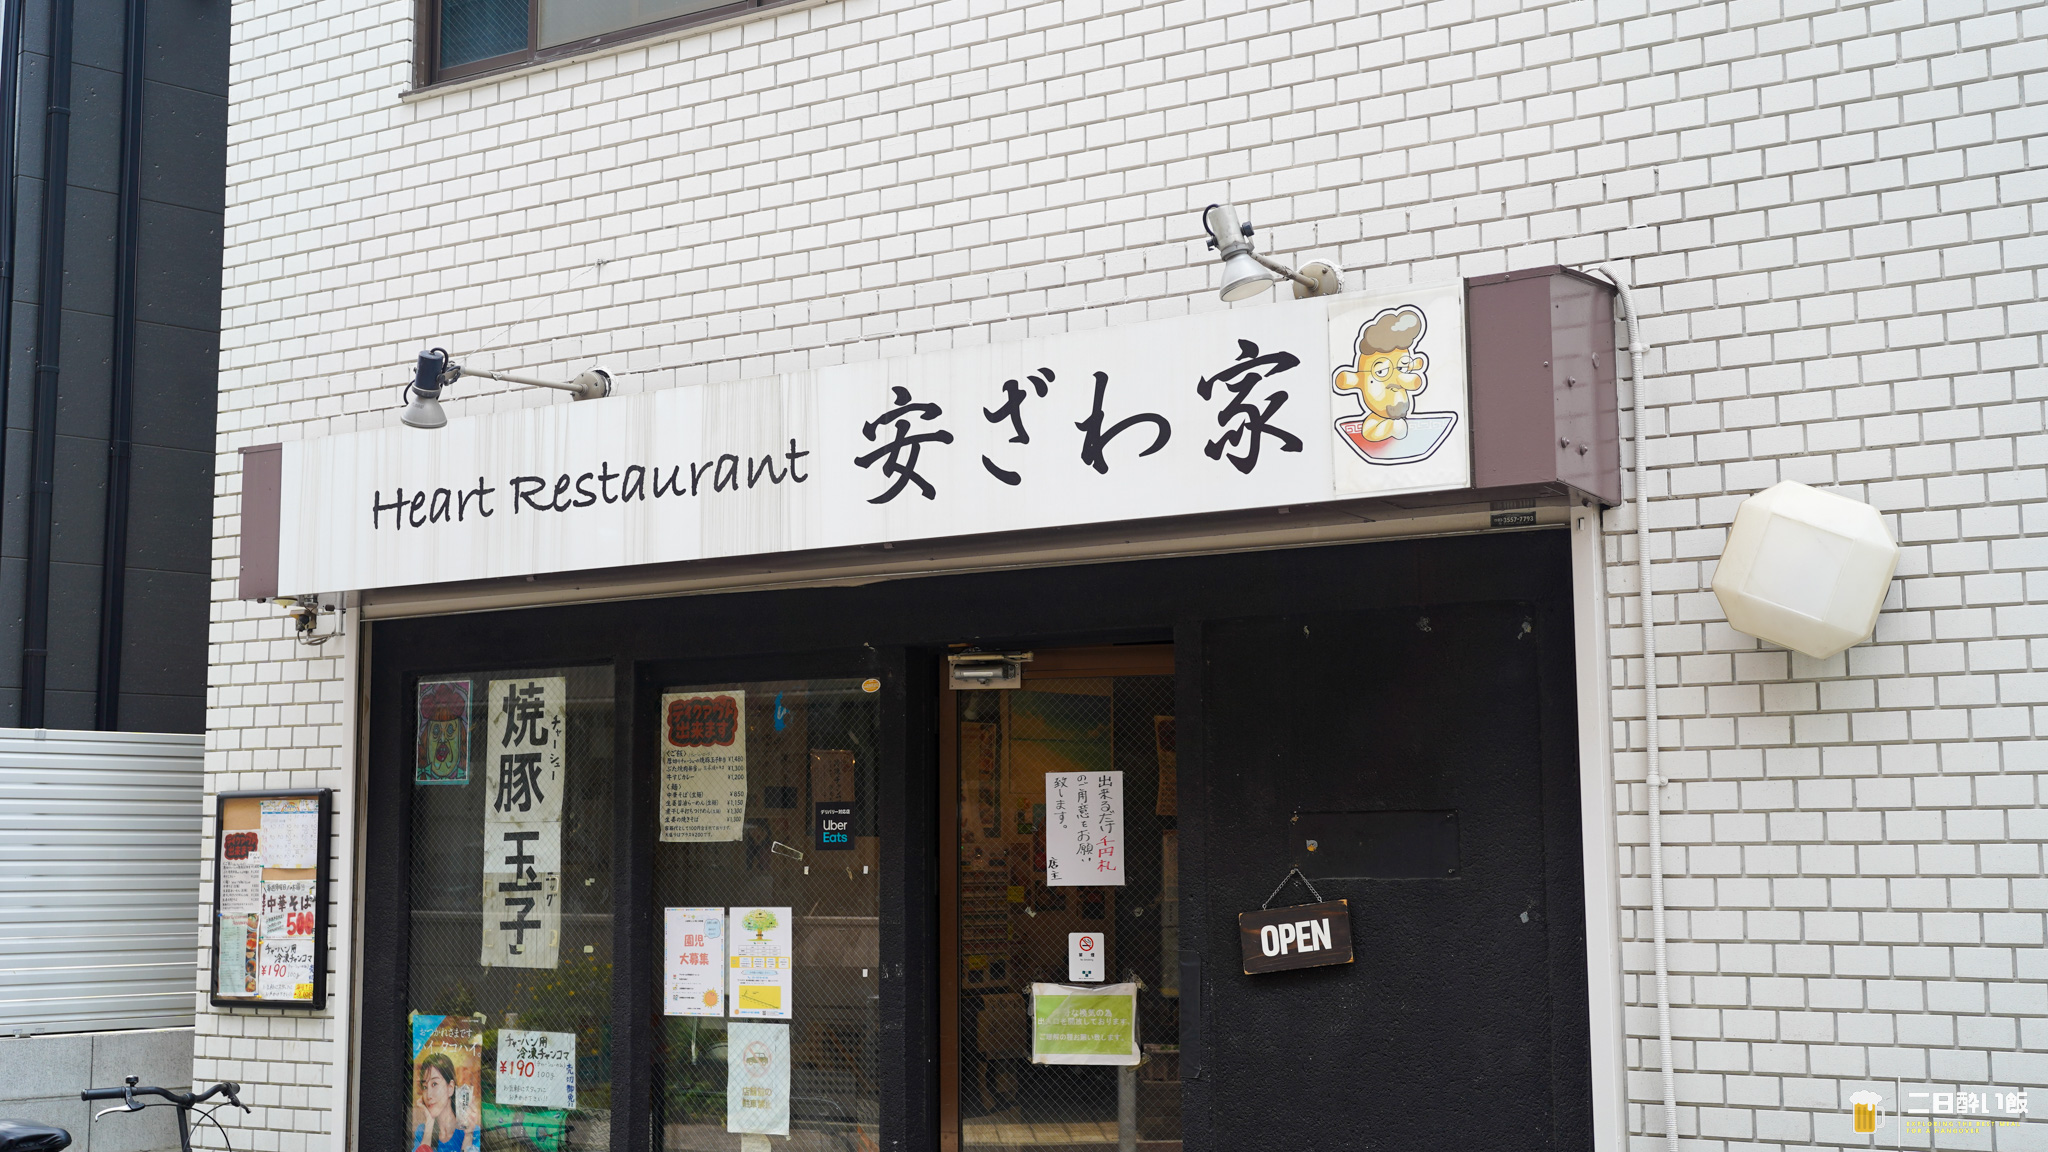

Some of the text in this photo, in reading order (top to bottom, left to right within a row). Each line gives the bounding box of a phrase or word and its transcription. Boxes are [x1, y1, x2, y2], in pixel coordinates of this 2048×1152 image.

[854, 339, 1303, 505] 安ざわ家
[373, 439, 809, 530] Heart Restaurant
[675, 720, 729, 739] 出来ます
[550, 714, 562, 781] チャーシュー
[1053, 777, 1068, 829] 致します。
[494, 681, 549, 955] 焼豚玉子
[822, 819, 848, 831] Uber
[822, 832, 848, 843] Eats
[1048, 857, 1063, 880] 店主
[267, 894, 312, 913] 中華そば
[286, 911, 314, 935] 500
[684, 934, 705, 947] 園児
[1260, 918, 1332, 957] OPEN
[679, 952, 709, 966] 大募集
[261, 963, 287, 977] ¥190
[420, 1027, 473, 1038] おつかれさまです
[499, 1059, 535, 1078] ¥190
